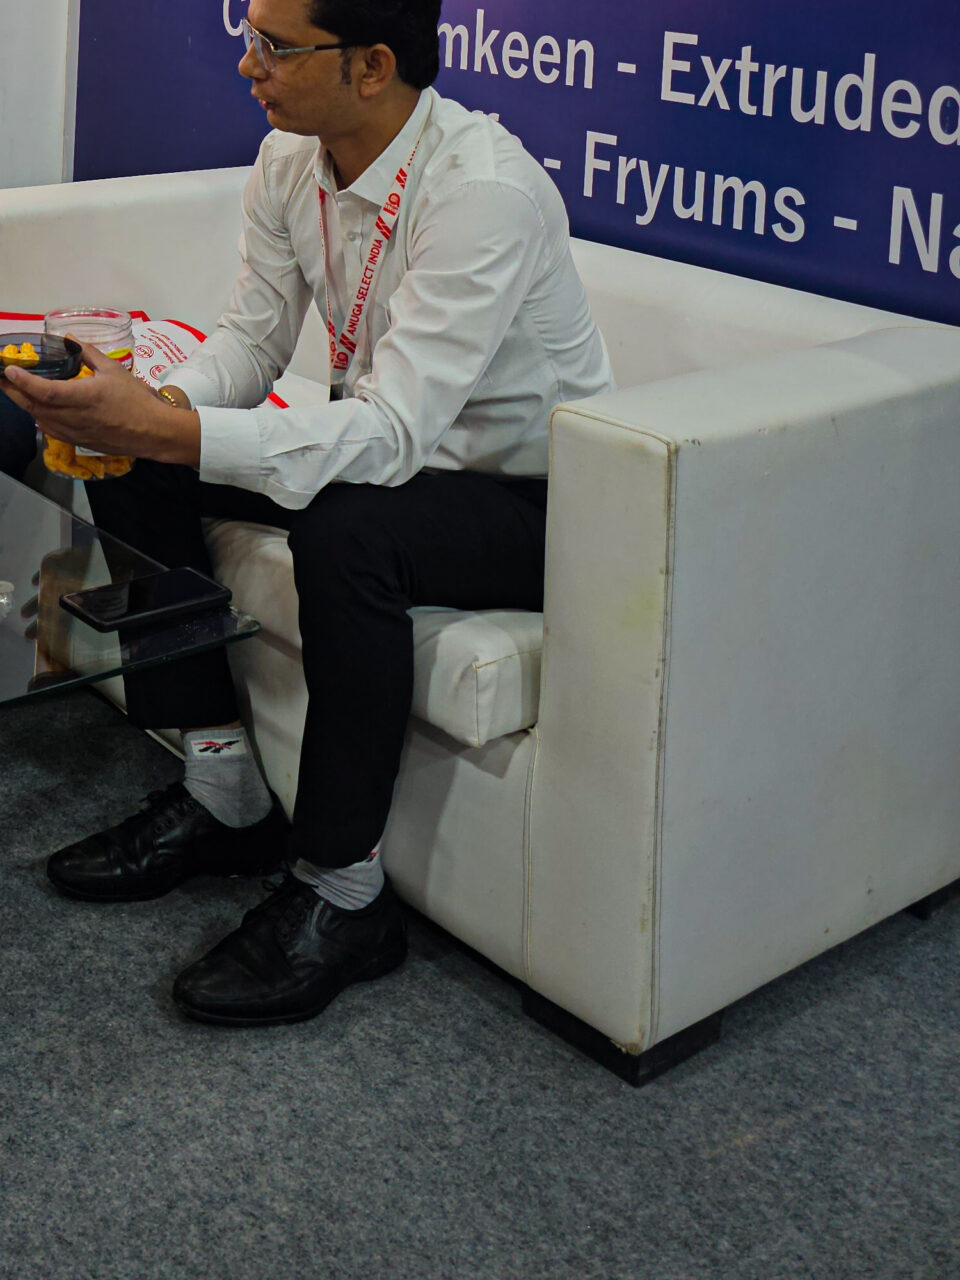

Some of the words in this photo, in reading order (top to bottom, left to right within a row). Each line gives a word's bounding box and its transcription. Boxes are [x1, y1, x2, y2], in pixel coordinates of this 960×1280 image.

[582, 129, 806, 244] Fryums
[346, 303, 365, 336] ANUGA
[356, 264, 375, 302] SELECT
[367, 238, 384, 266] INDIA
